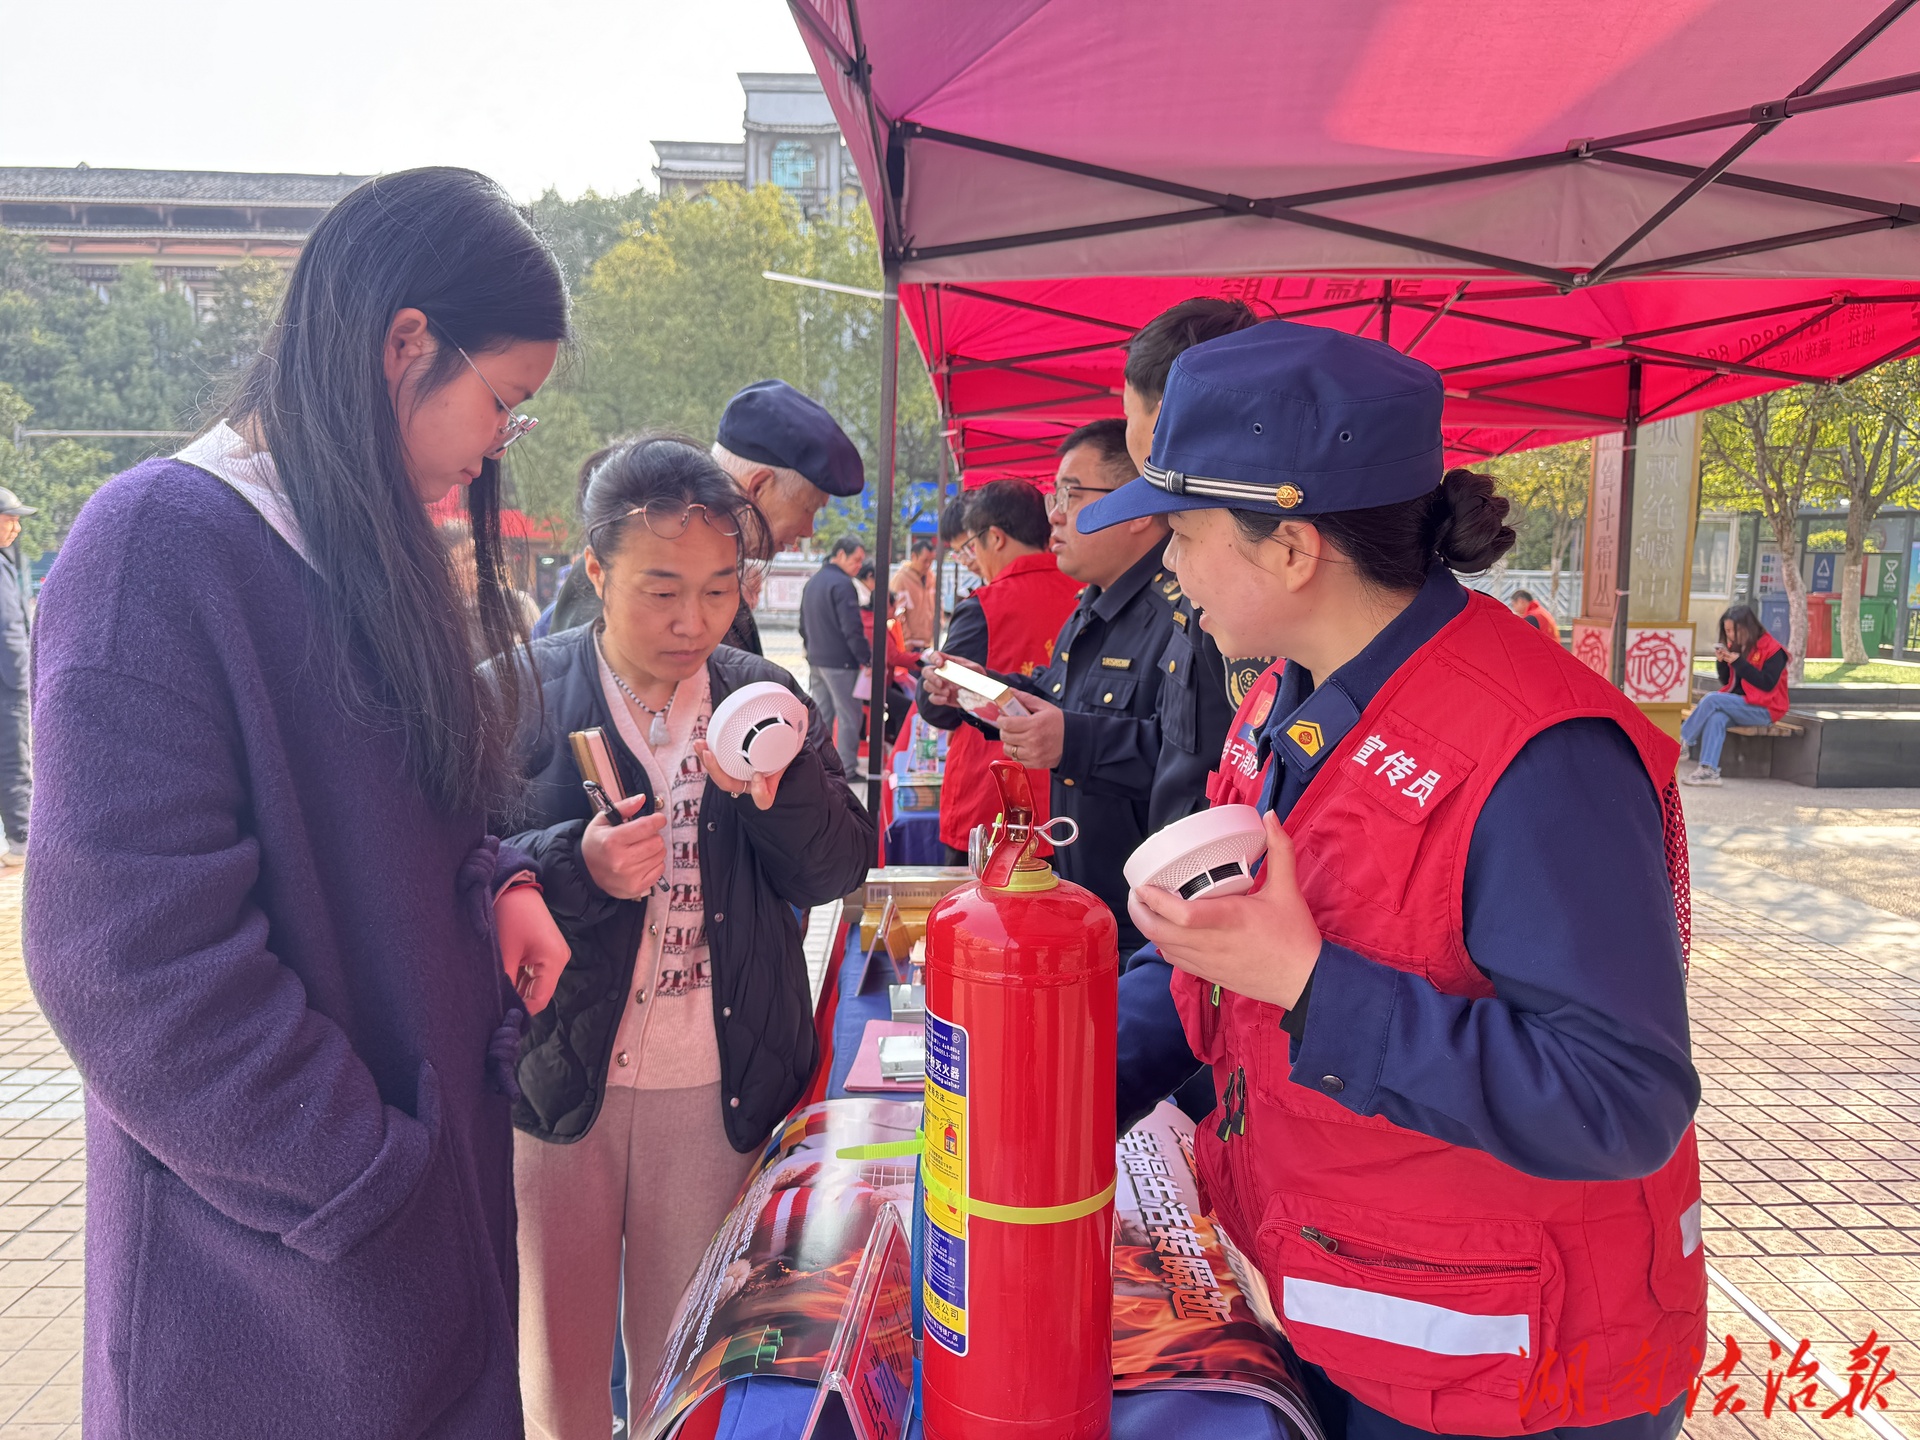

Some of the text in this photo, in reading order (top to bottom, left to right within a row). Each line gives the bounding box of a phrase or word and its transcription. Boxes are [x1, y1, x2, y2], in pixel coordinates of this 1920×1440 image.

[1352, 734, 1442, 808] 宣传员
[1118, 1129, 1234, 1323] 幸福生活转瞬逝
